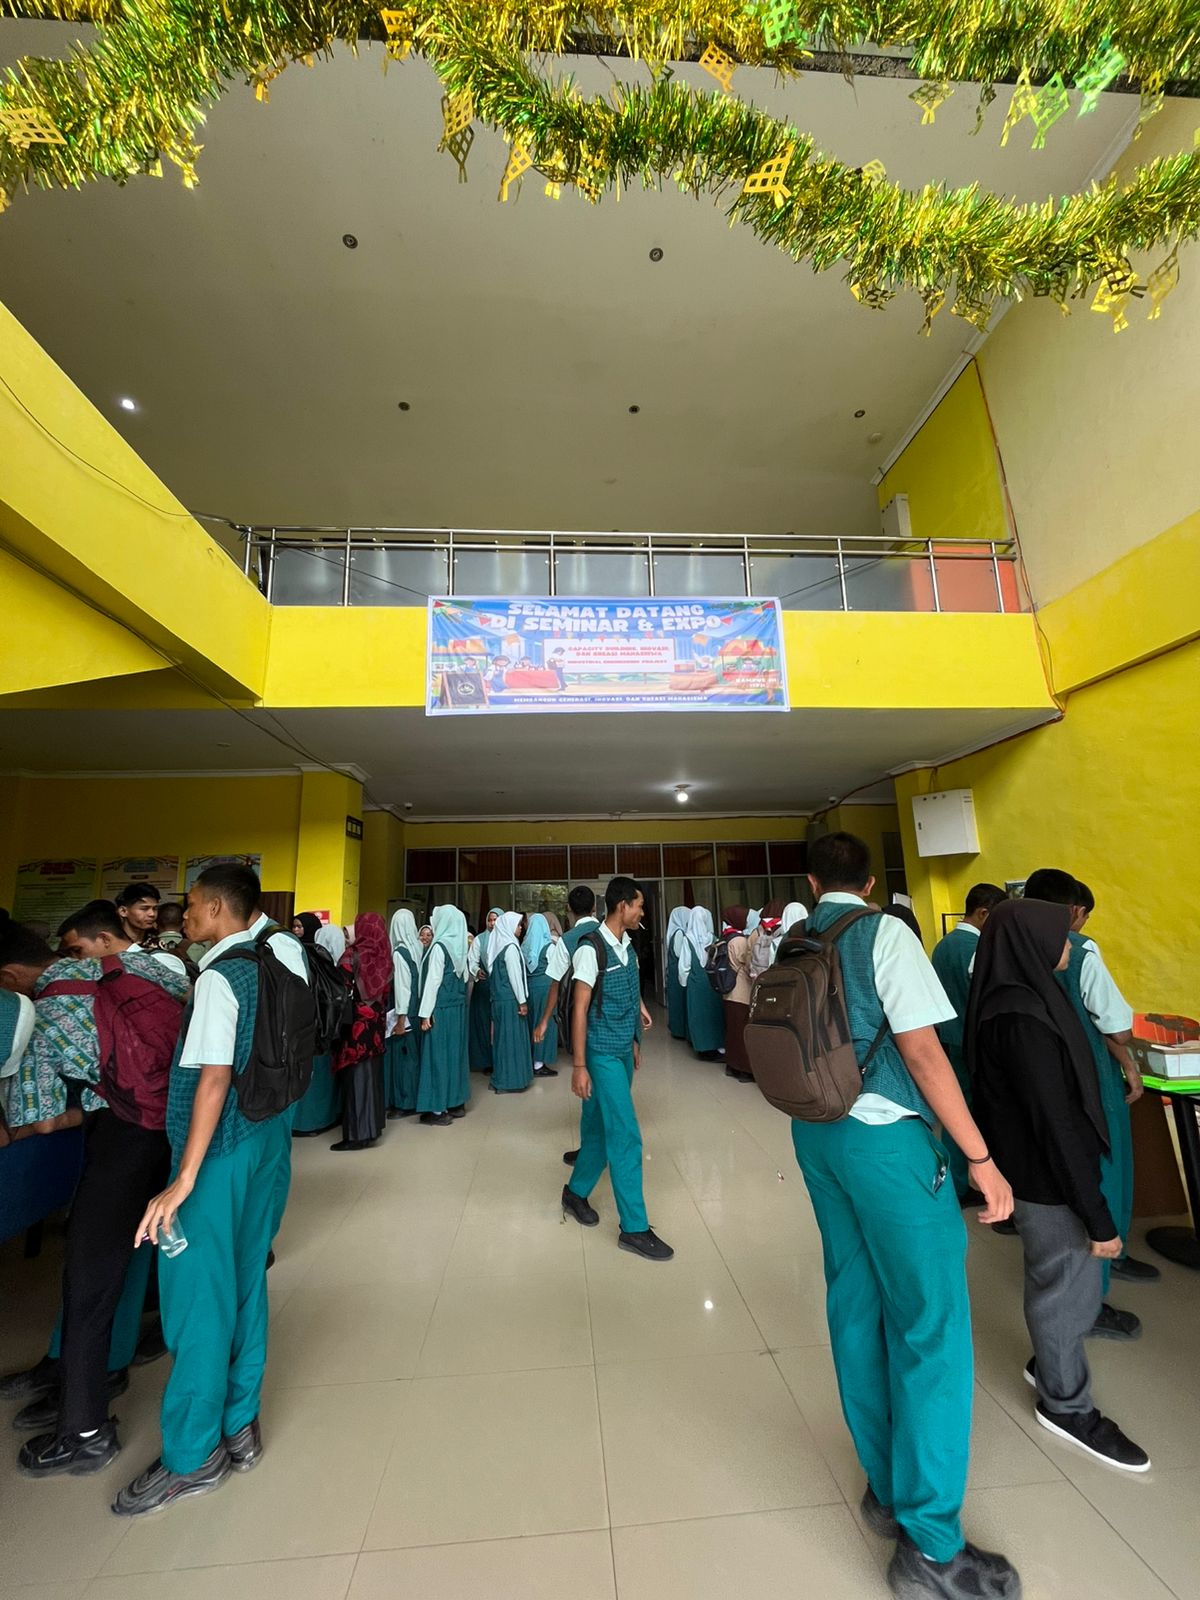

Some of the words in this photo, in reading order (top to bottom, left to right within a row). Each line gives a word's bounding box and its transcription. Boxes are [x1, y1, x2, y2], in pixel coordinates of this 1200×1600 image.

[508, 603, 609, 618] SELAMAT
[616, 604, 705, 618] DATANG
[491, 616, 516, 630] DI
[523, 616, 629, 632] SEMINAR
[637, 617, 655, 632] &
[662, 615, 723, 631] EXPO
